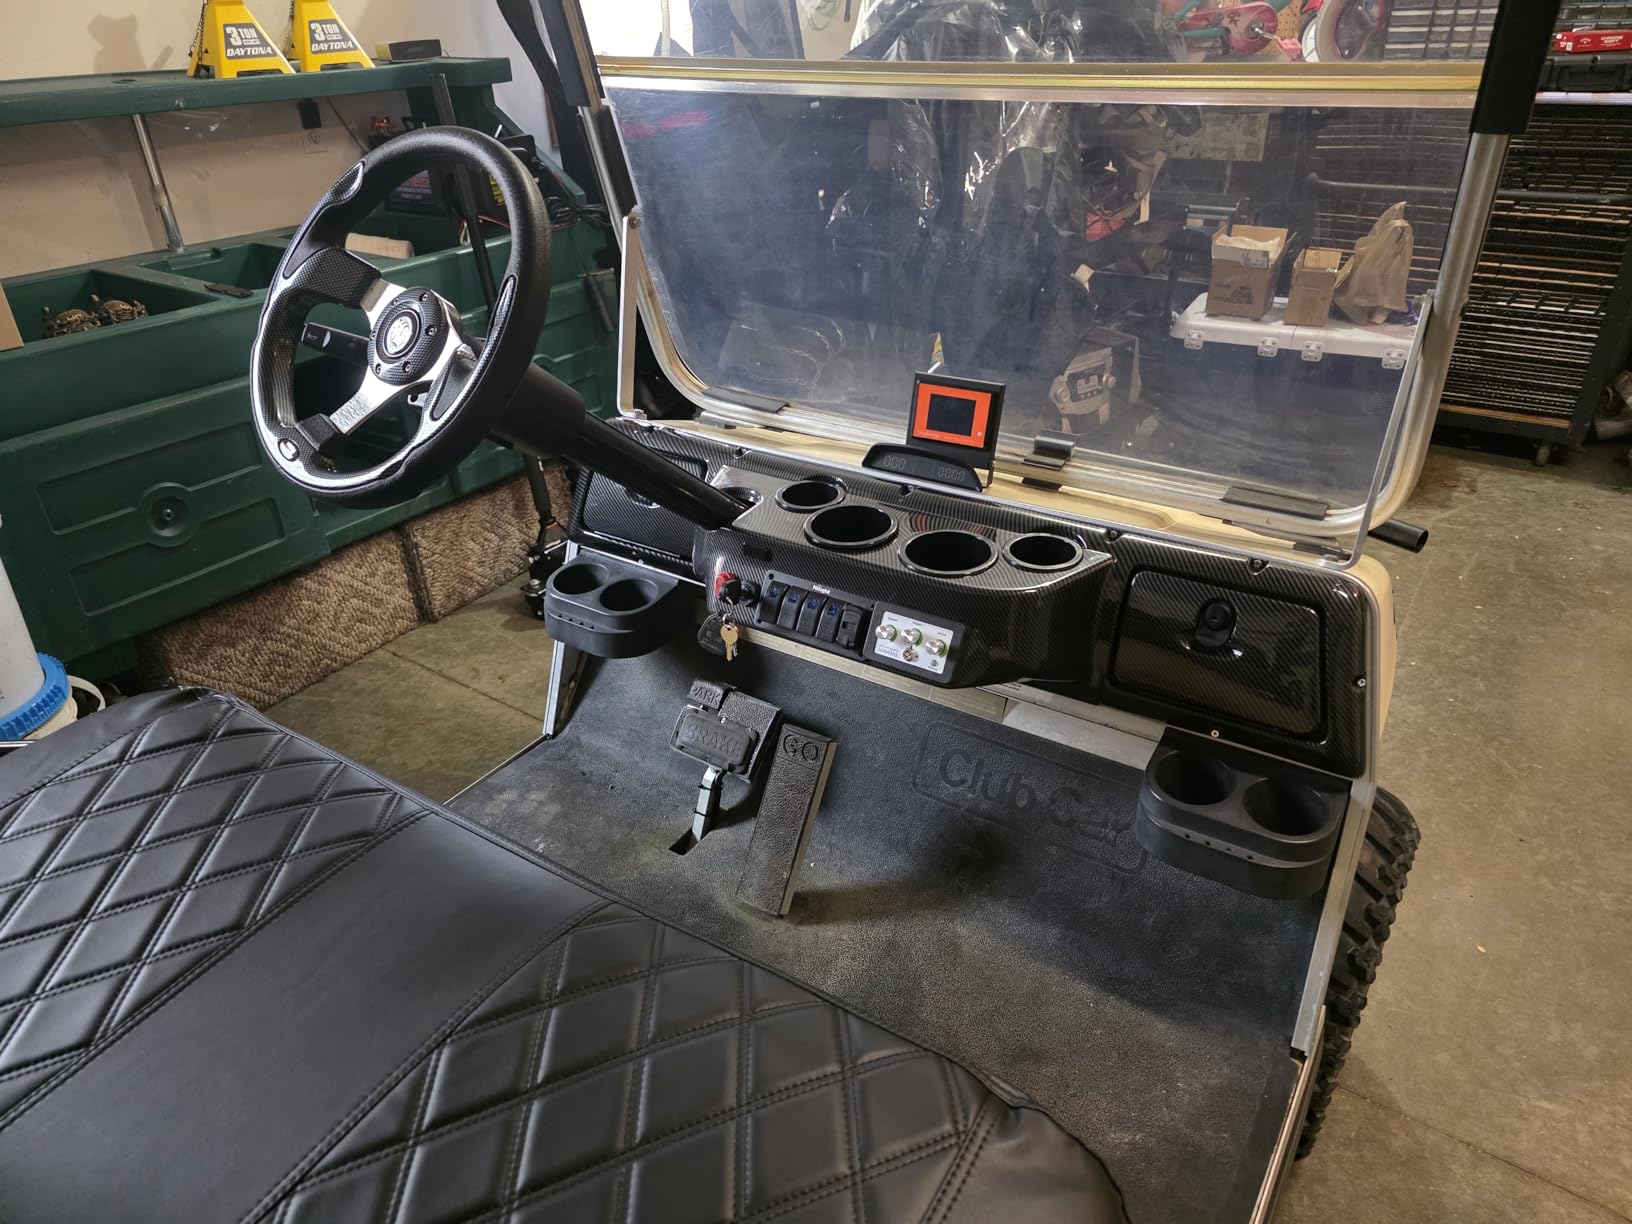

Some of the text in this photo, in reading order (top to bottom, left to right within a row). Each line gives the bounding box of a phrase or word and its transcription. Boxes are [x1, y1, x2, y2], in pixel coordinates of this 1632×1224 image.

[226, 26, 258, 46] 3 TON
[310, 22, 340, 41] 3 TON
[227, 46, 273, 57] DAYTONA
[311, 40, 353, 52] DAYTONA
[684, 724, 743, 760] BRAKE
[783, 733, 819, 763] GO
[938, 748, 1037, 811] Club
